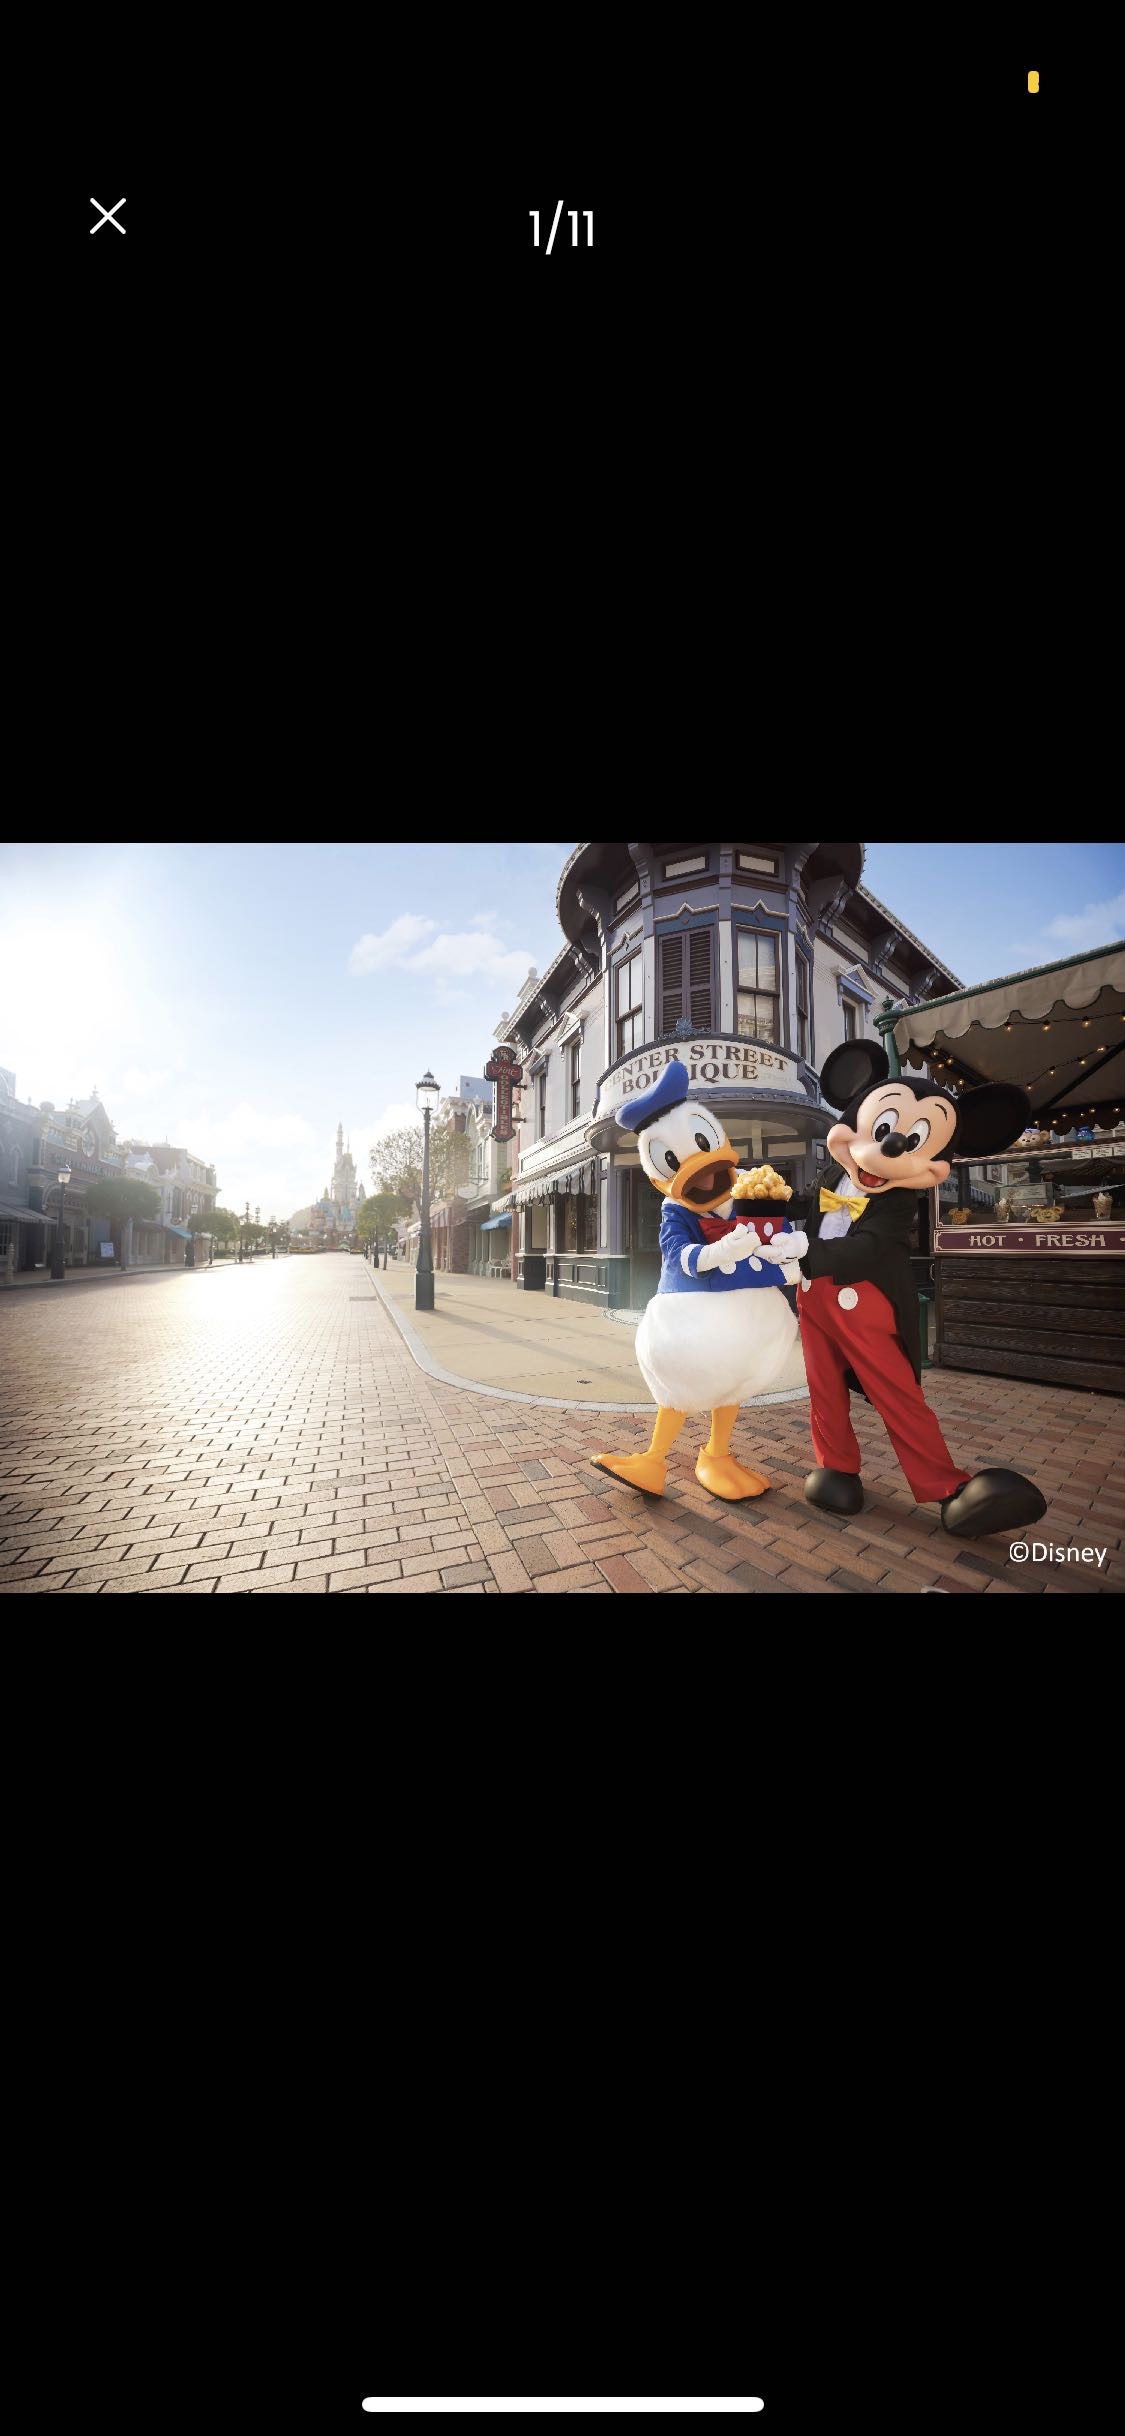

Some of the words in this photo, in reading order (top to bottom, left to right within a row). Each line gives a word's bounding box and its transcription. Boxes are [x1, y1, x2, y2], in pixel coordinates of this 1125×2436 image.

[689, 1044, 788, 1072] STREET
[622, 1062, 759, 1095] BOIQUE
[969, 1234, 1007, 1247] HOT
[1035, 1234, 1107, 1247] FRESH
